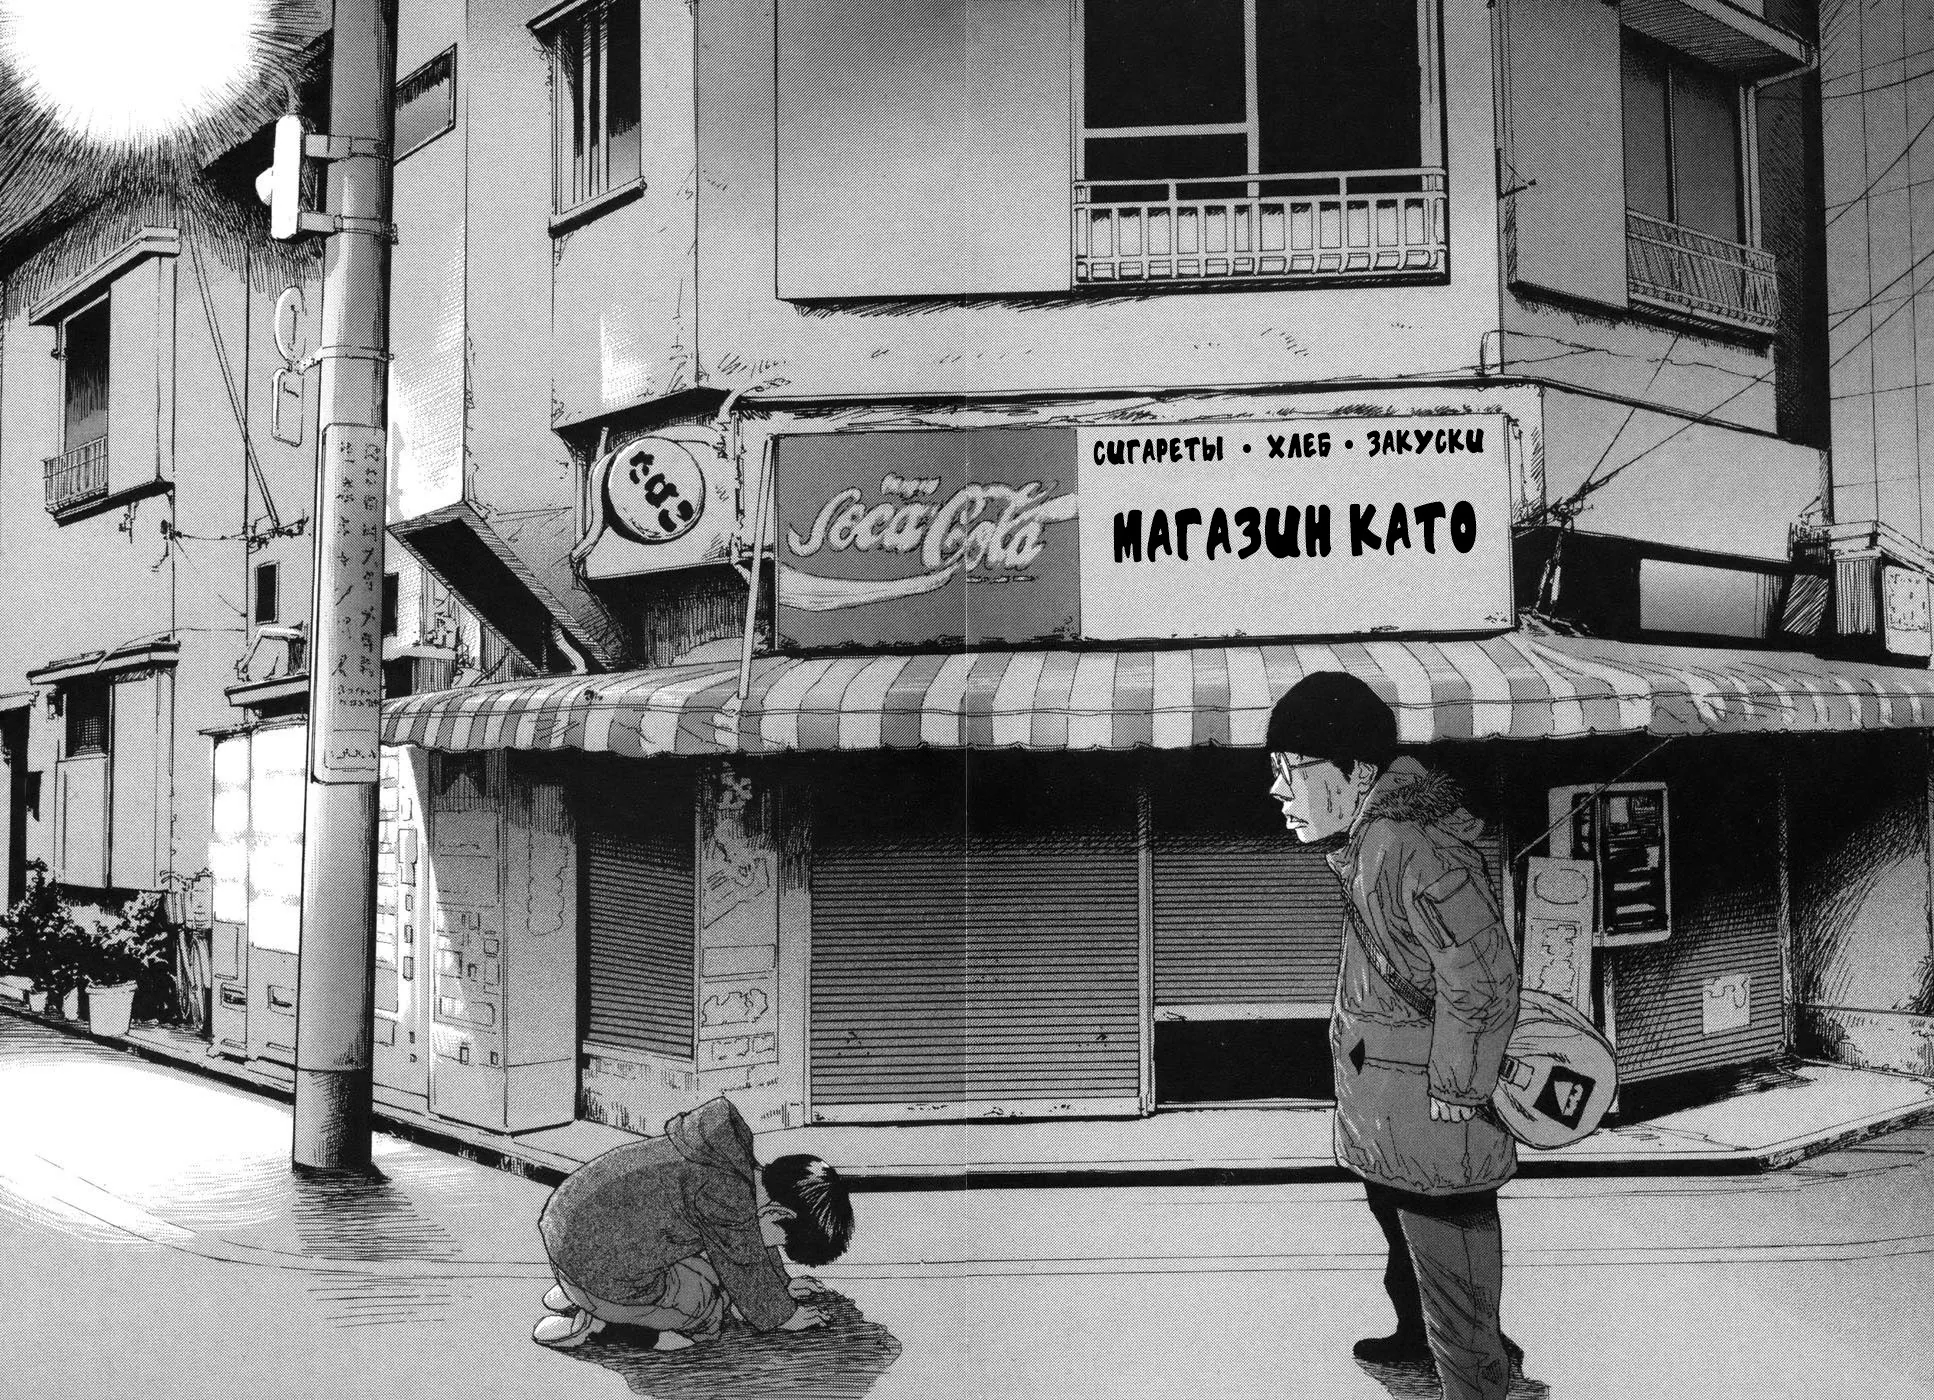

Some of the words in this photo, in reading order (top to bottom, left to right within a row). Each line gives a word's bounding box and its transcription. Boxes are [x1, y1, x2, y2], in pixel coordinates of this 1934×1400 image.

[1093, 436, 1224, 466] СИГАРЕТЫ
[1267, 432, 1332, 459] ХЛЕБ
[1367, 428, 1485, 457] ЗАКУСКИ
[1113, 504, 1332, 563] МАГАЗИН
[1349, 500, 1478, 557] КАТО
